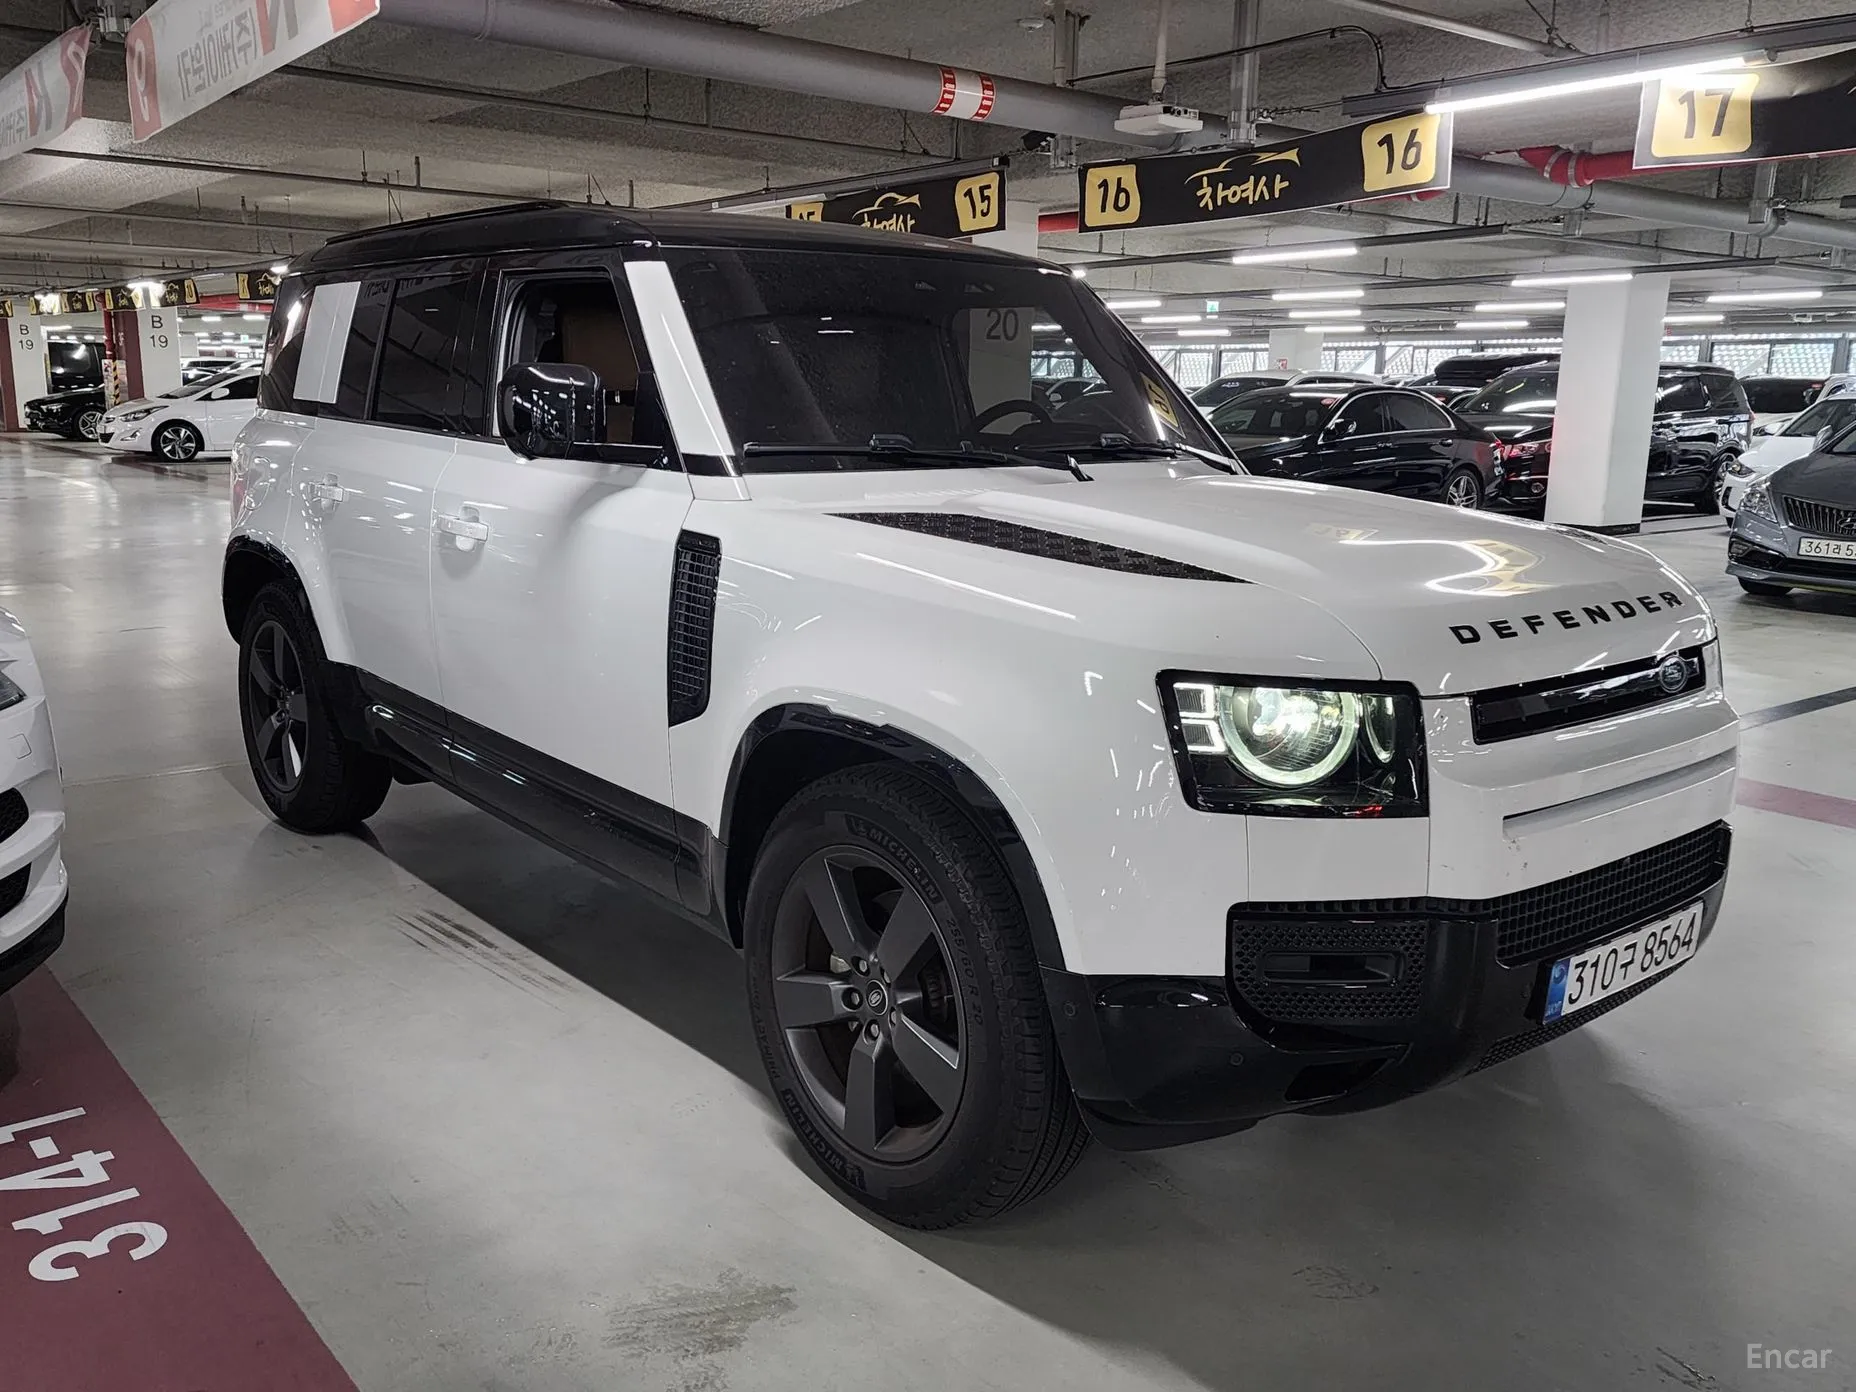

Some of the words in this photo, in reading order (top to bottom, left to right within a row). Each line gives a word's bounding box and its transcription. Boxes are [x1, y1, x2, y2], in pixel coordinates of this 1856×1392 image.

[1678, 87, 1736, 139] 17
[1377, 128, 1421, 175] 16
[963, 184, 992, 219] 15
[1097, 177, 1131, 213] 16
[1196, 173, 1291, 211] 차여사
[19, 324, 30, 336] B
[151, 315, 163, 329] B
[986, 308, 1019, 342] 20
[18, 339, 34, 351] 19
[150, 335, 168, 348] 19
[1448, 591, 1684, 645] DEFENDER
[869, 827, 940, 900] MICHELIN
[1640, 911, 1698, 973] 8564
[0, 1106, 168, 1282] 314-1
